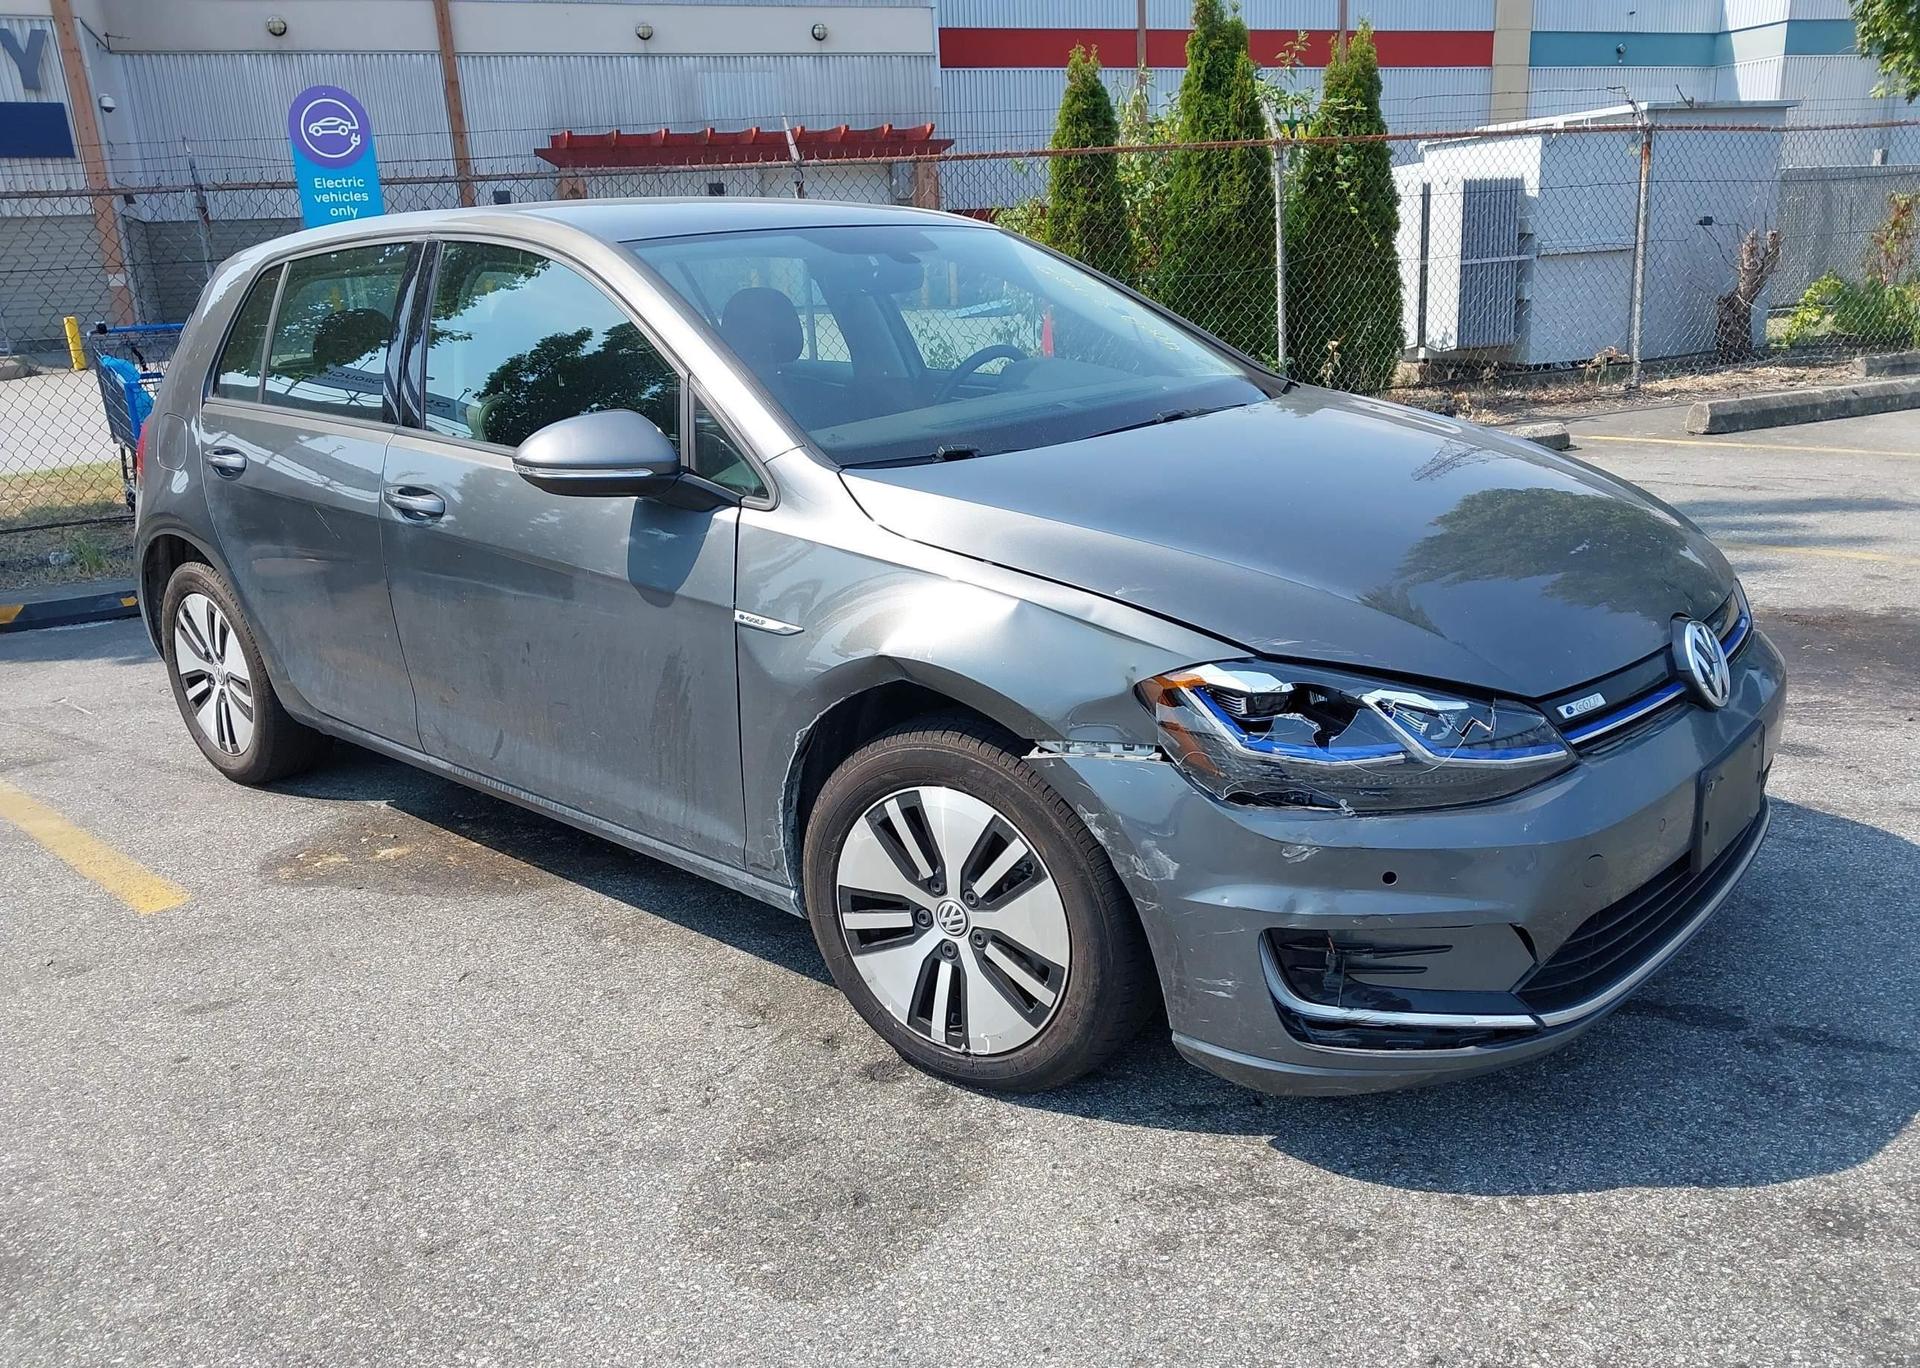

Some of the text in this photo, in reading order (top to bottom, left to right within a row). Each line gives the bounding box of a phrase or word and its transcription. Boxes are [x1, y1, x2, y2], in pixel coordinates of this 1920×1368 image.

[0, 28, 47, 90] Y
[313, 177, 365, 189] Electric
[314, 191, 369, 203] vehicles
[329, 205, 358, 219] only
